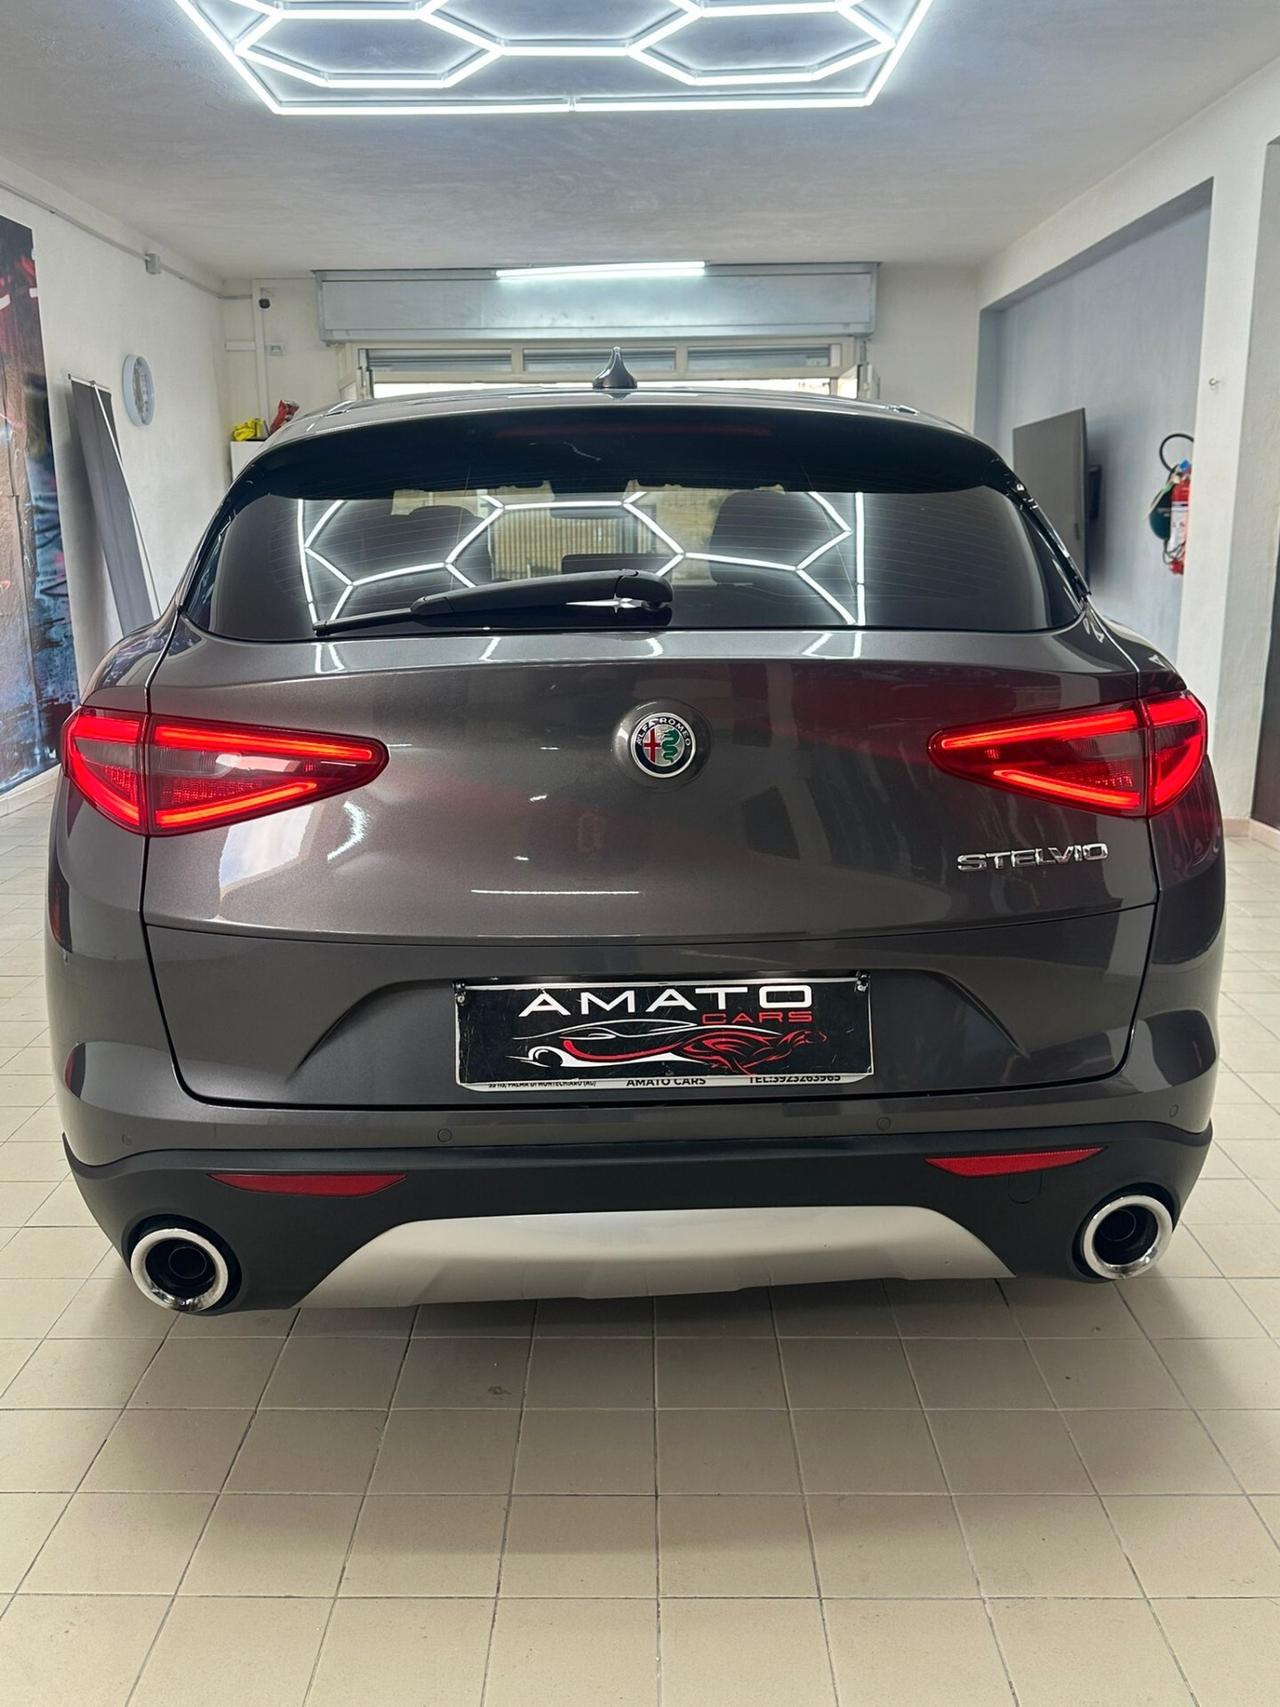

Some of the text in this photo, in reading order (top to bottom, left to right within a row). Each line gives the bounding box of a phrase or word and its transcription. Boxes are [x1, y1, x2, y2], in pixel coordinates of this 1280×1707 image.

[636, 717, 692, 747] ALFA ROMEO
[957, 843, 1109, 872] STELVIO
[518, 985, 812, 1018] AMATO
[702, 1011, 813, 1025] CARS
[626, 1077, 707, 1087] AMATO CARS
